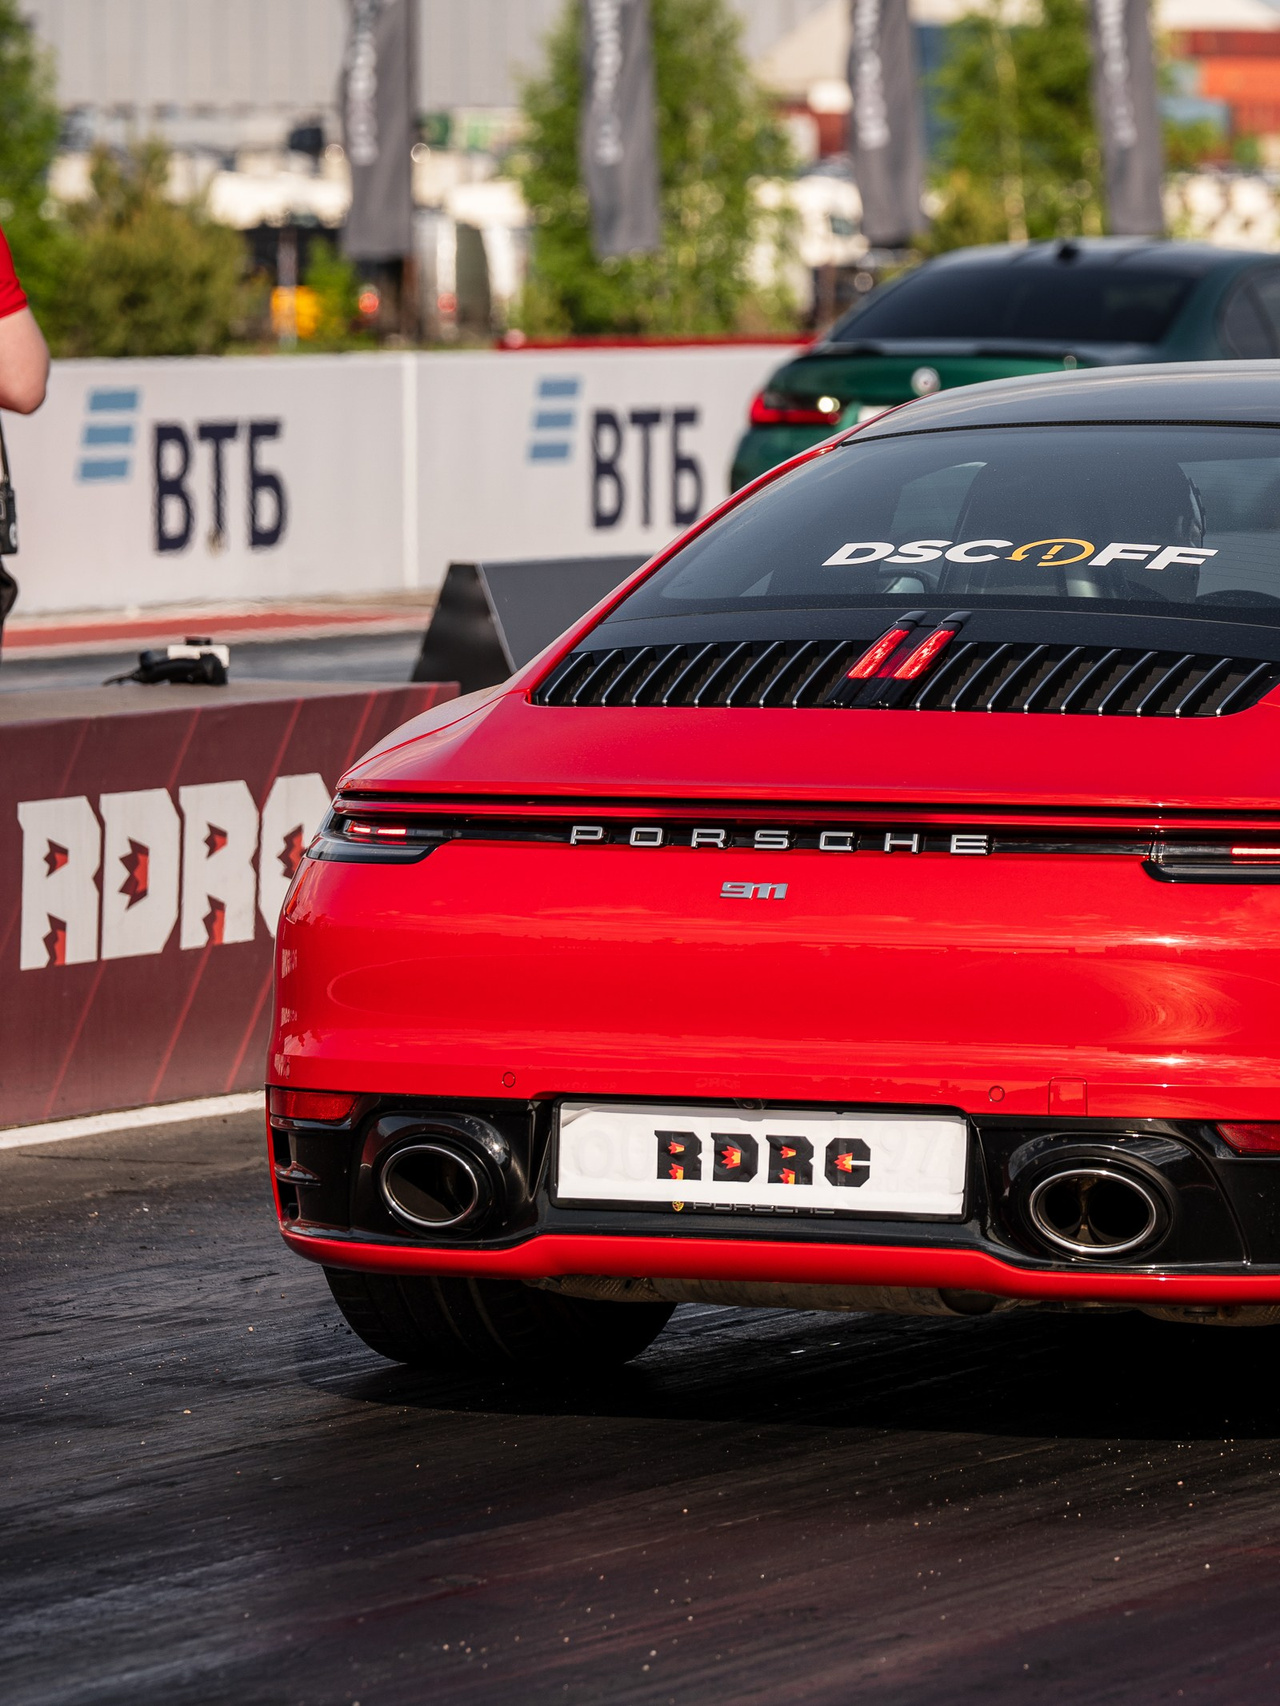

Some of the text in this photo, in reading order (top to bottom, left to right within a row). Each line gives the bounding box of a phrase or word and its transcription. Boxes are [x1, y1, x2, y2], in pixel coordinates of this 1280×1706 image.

[153, 417, 288, 554] ВТБ
[593, 409, 704, 529] ВТБ
[569, 825, 991, 856] PORSCHE
[720, 881, 788, 900] 911
[654, 1130, 871, 1188] RDRC
